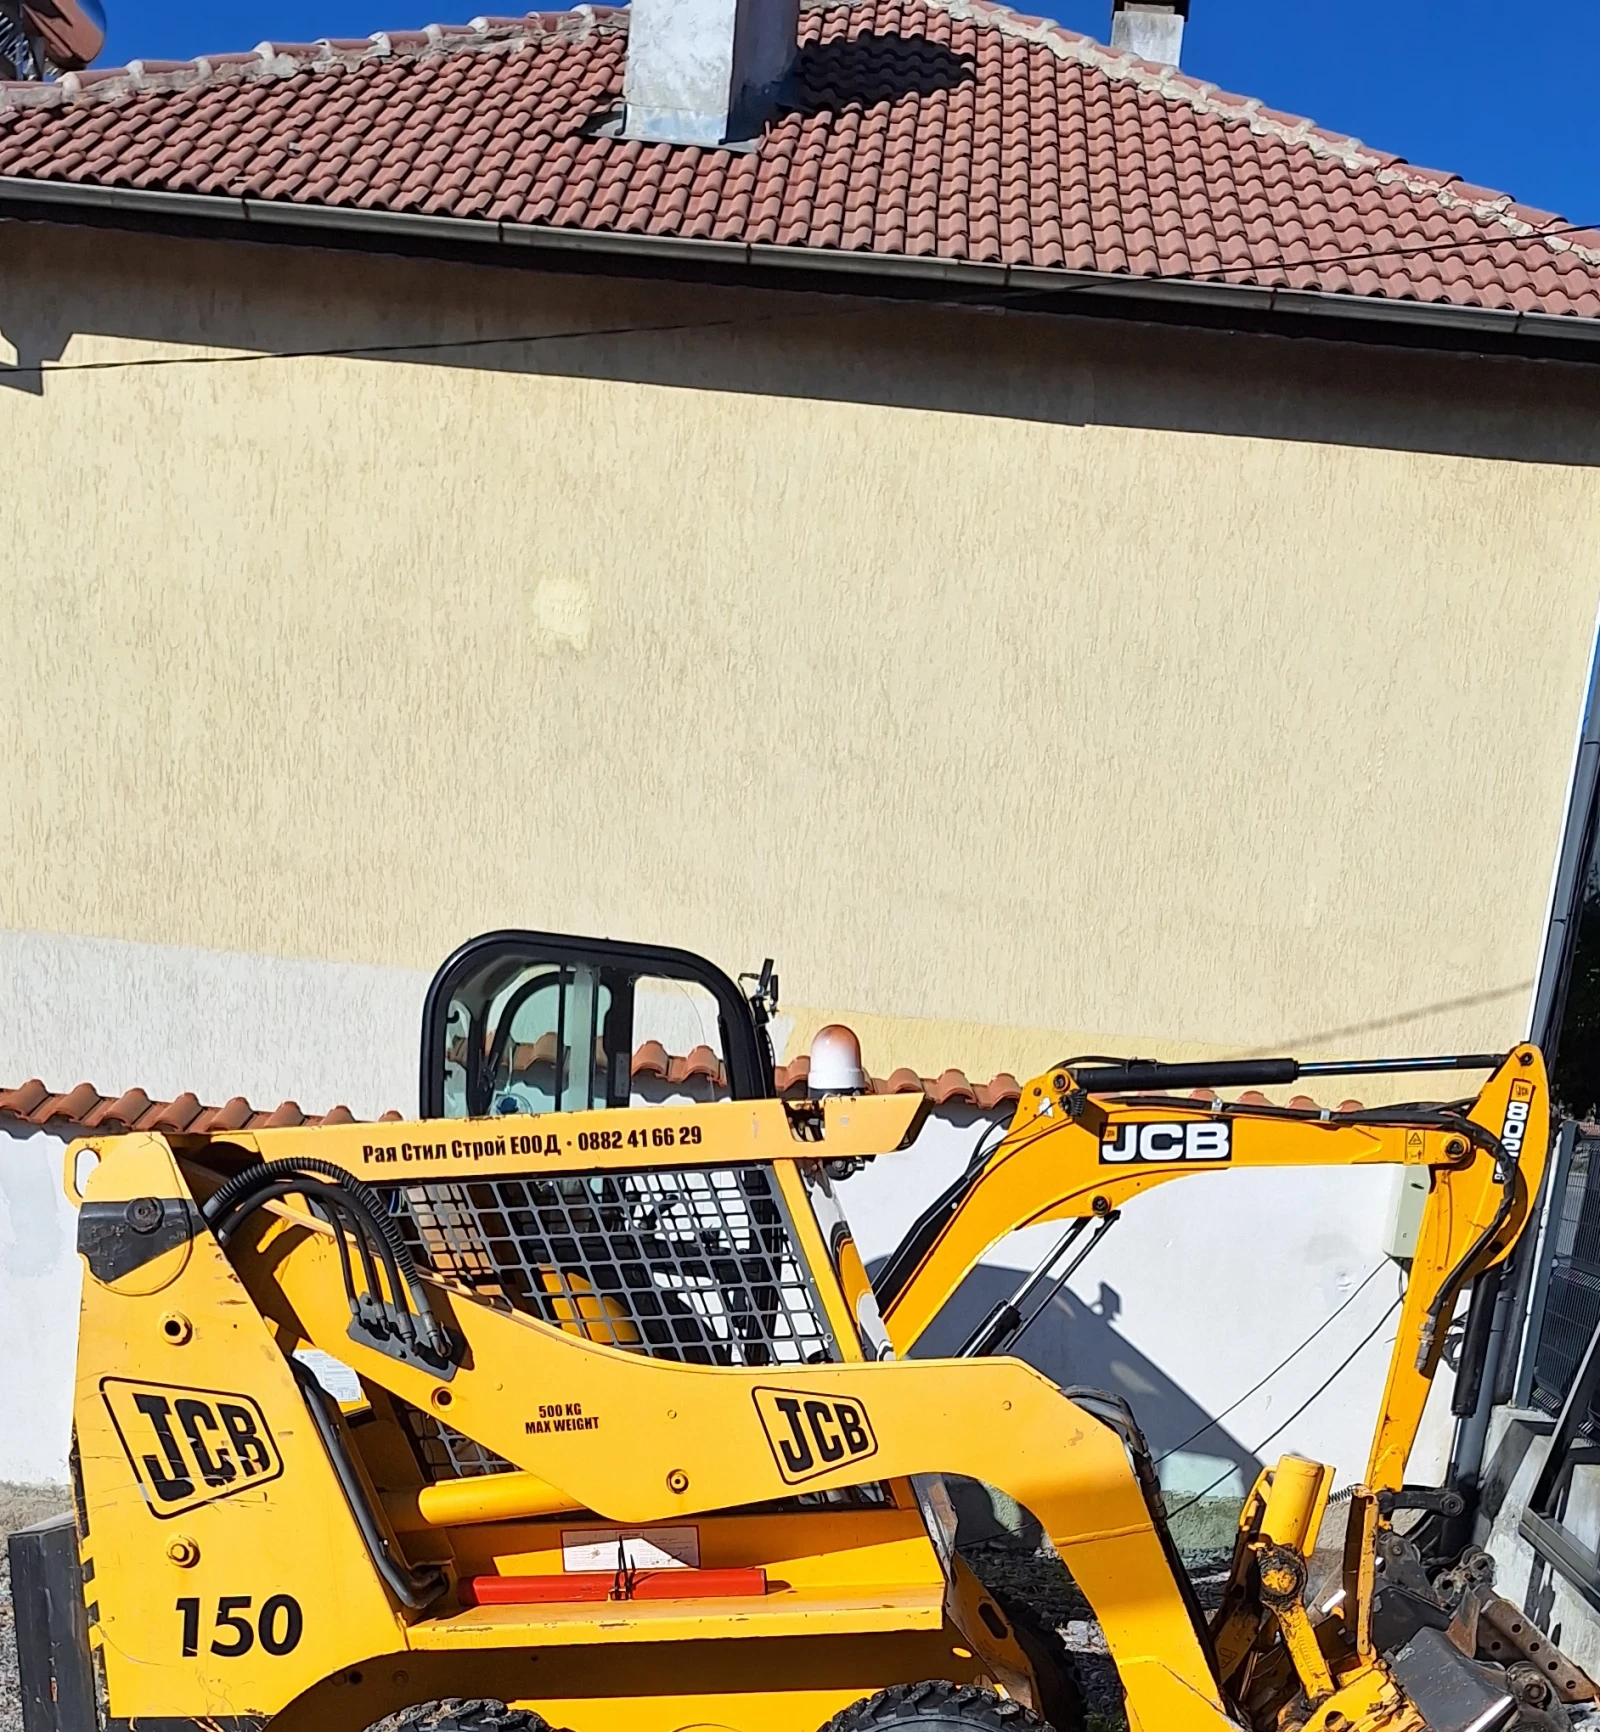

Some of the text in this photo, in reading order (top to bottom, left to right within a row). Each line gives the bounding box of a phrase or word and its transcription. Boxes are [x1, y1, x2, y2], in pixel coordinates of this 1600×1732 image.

[362, 1125, 702, 1164] Рая Стил Строй ЕООД 0882 41 66 29
[1101, 1122, 1230, 1162] JCB
[525, 1416, 599, 1435] MAX WEIGHT
[538, 1403, 582, 1419] 500 KG
[132, 1393, 271, 1502] JCB
[774, 1397, 869, 1473] JCB
[175, 1593, 303, 1658] 150
